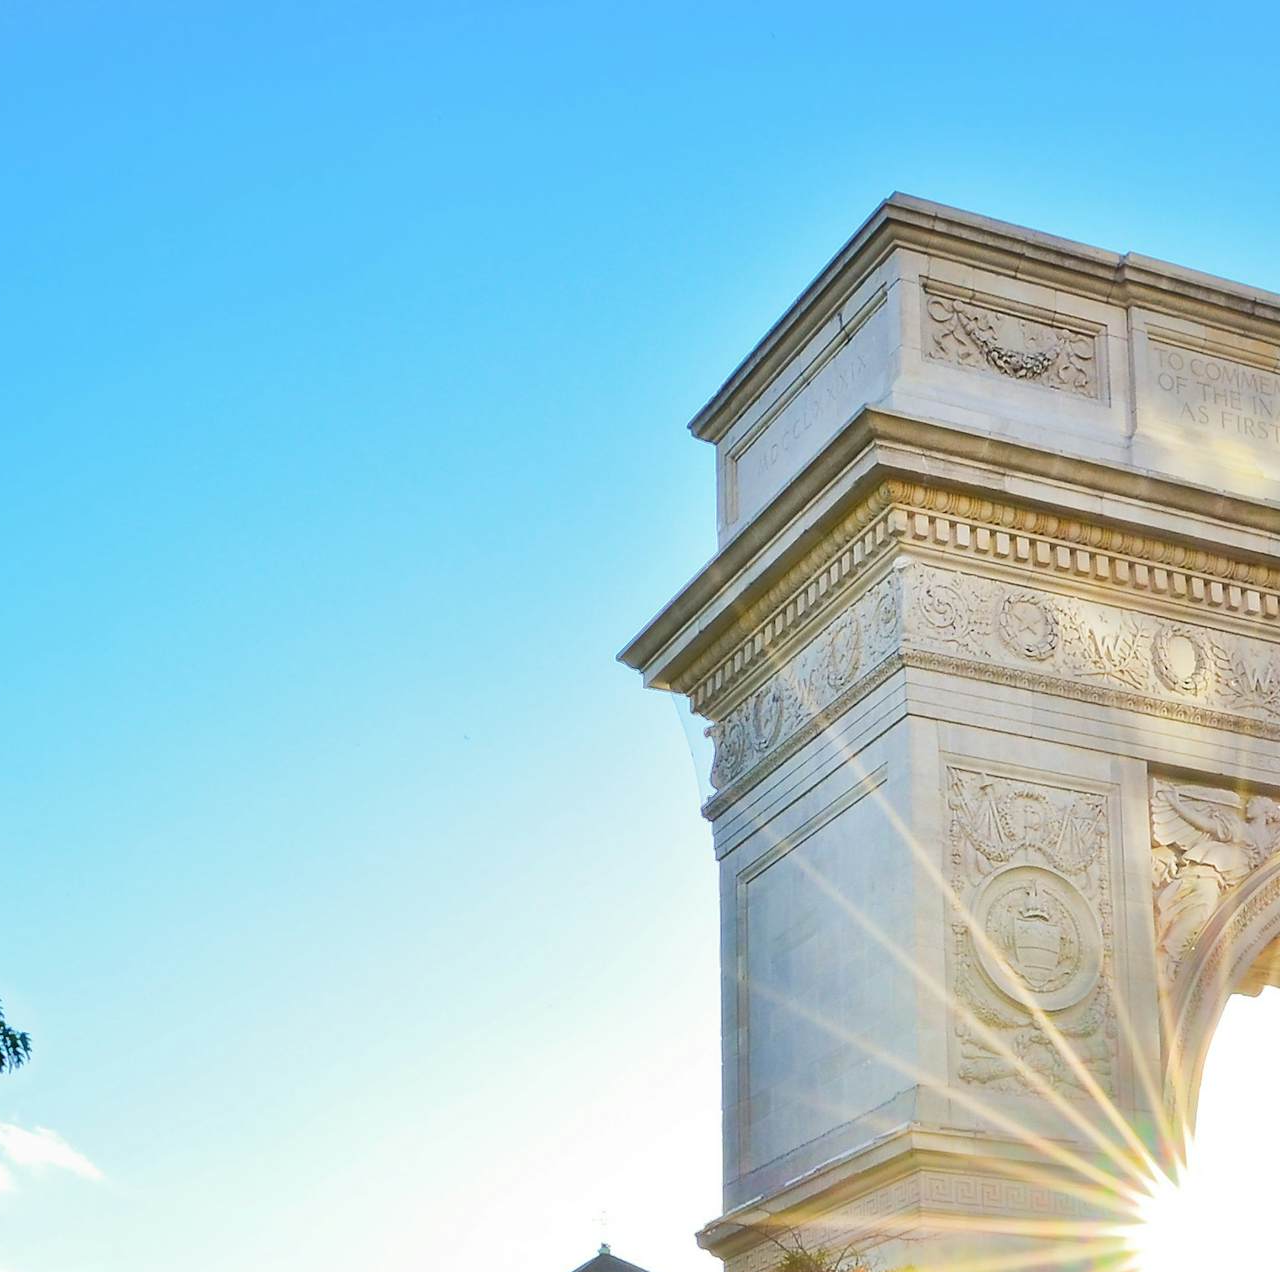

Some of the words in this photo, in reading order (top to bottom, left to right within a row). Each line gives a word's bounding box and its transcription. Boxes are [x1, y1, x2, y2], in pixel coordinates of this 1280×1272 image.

[1154, 347, 1183, 371] TO
[1158, 372, 1188, 394] OF
[1197, 381, 1242, 411] THE
[1180, 402, 1209, 425] AS
